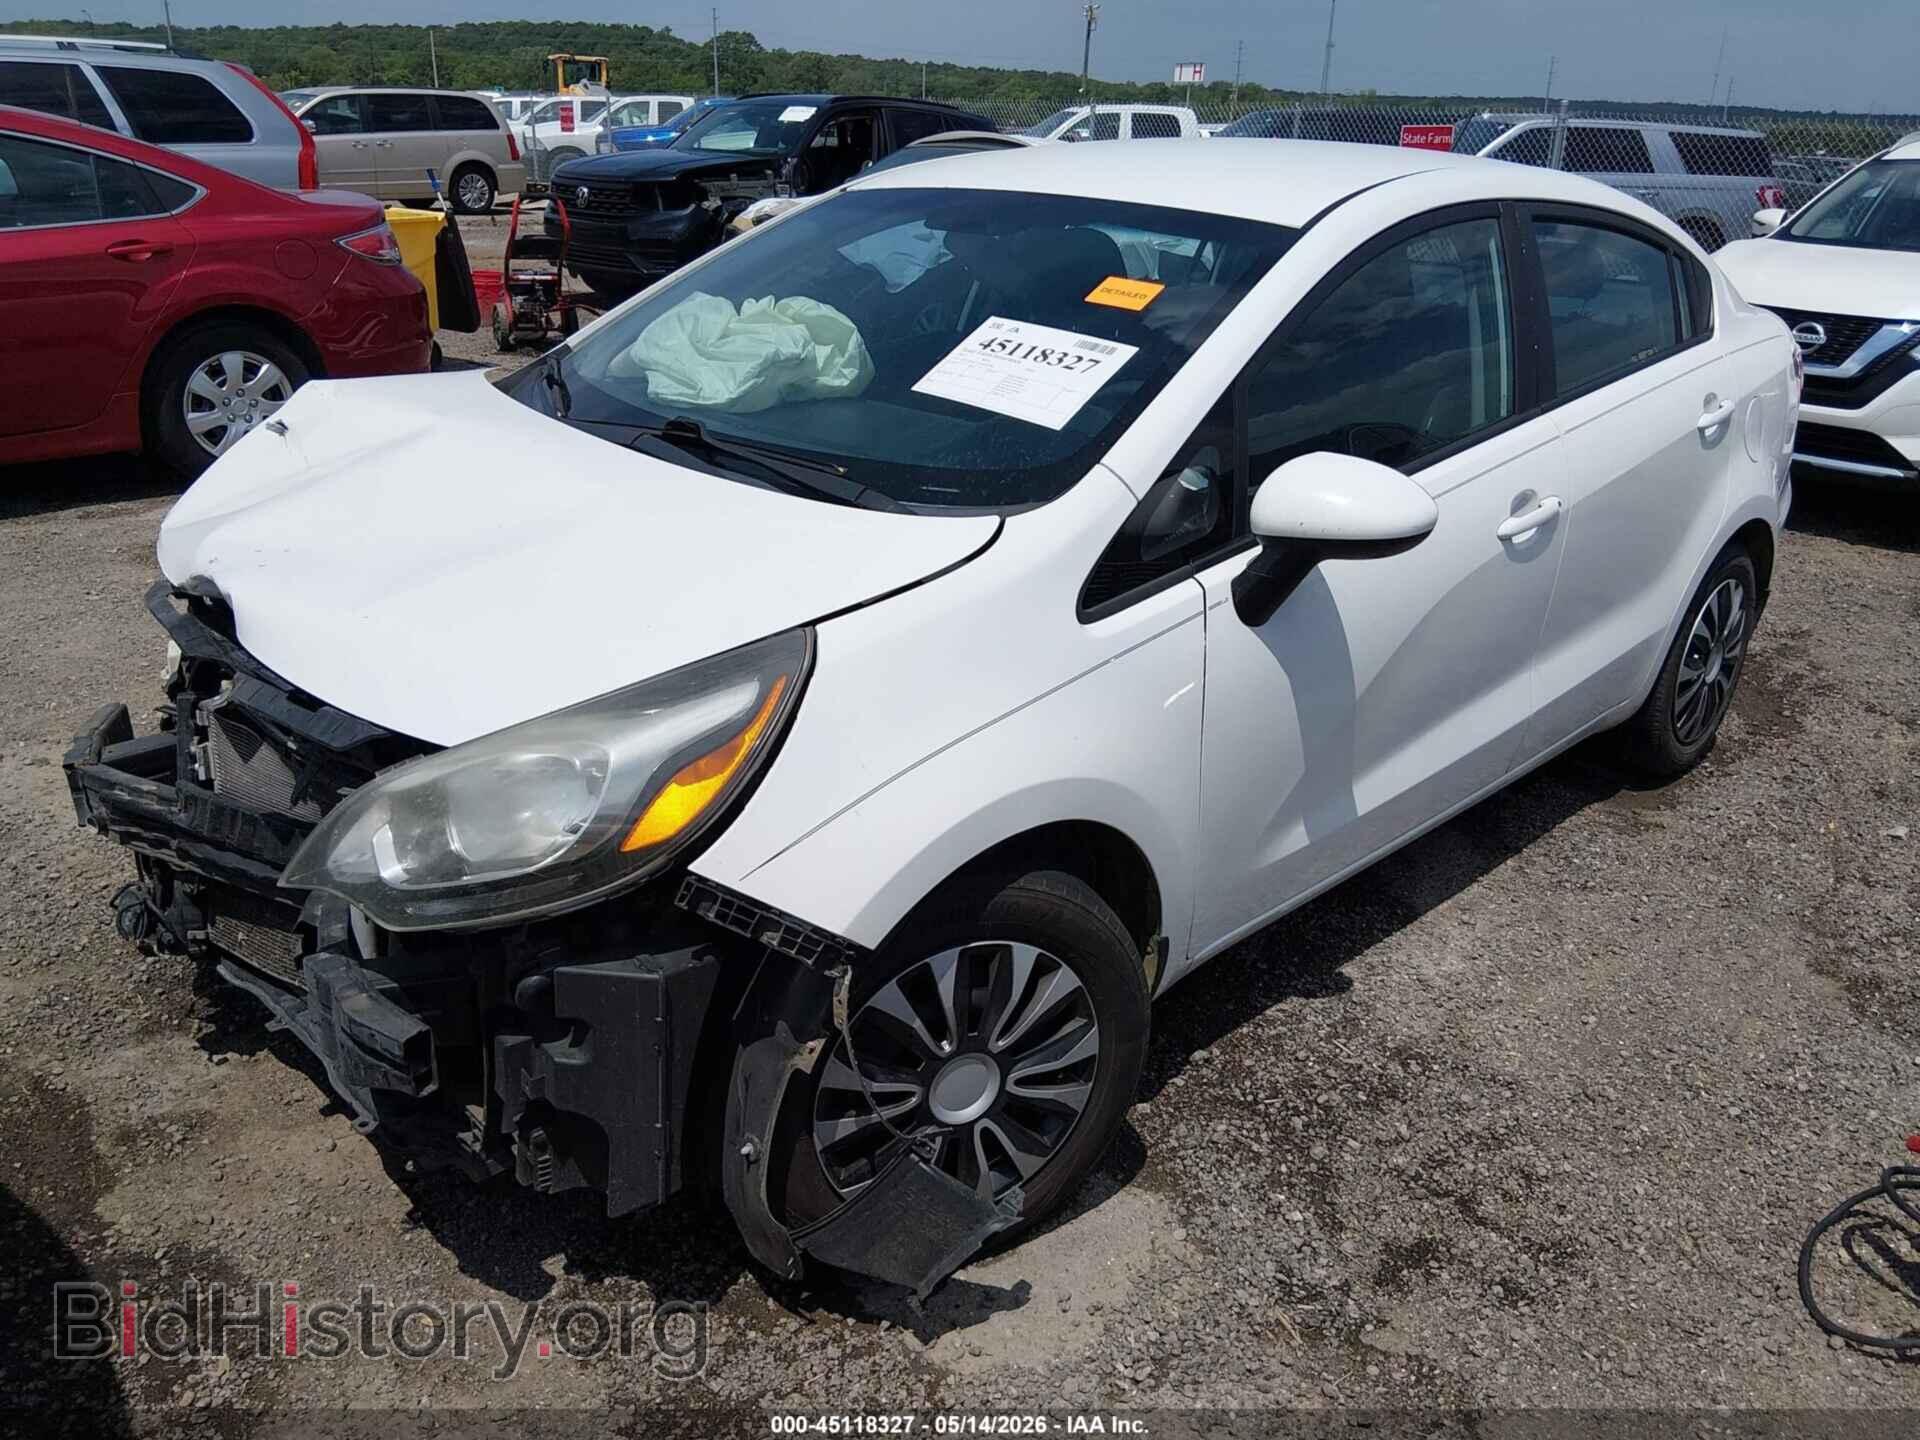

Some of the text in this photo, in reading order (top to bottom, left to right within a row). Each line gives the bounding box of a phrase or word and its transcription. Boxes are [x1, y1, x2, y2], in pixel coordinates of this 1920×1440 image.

[1402, 132, 1451, 144] State Farm
[1100, 287, 1148, 300] DETAILED
[978, 336, 1101, 374] 45118327
